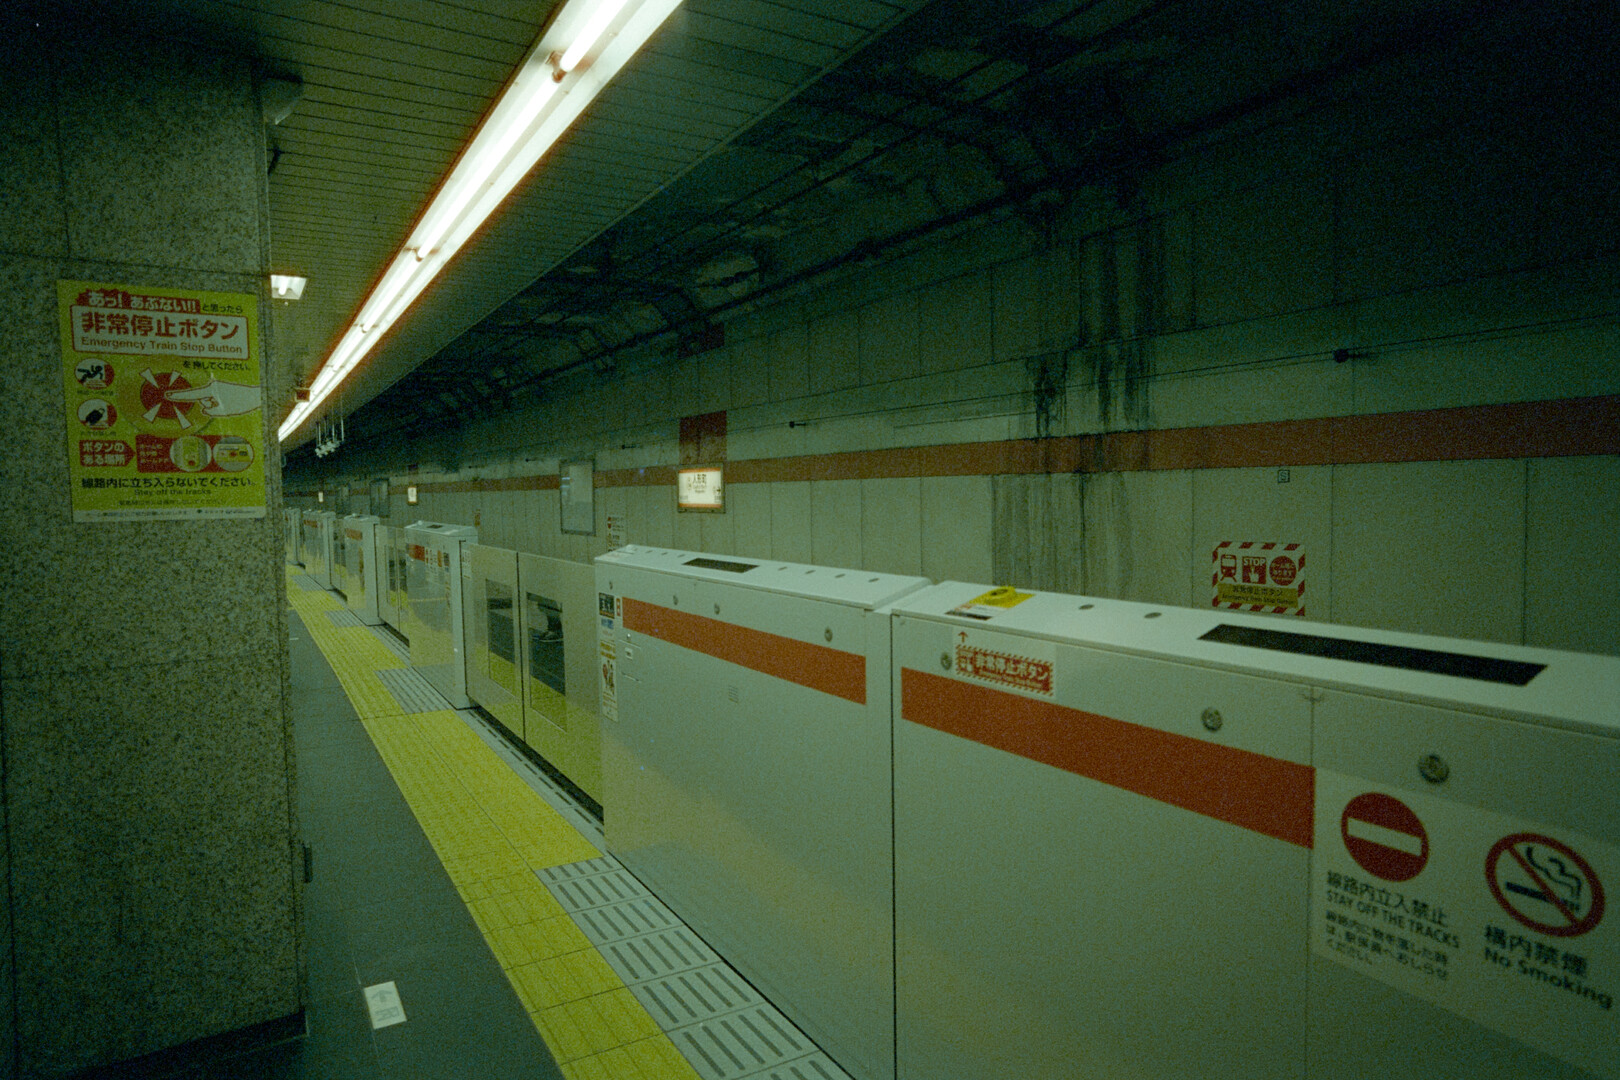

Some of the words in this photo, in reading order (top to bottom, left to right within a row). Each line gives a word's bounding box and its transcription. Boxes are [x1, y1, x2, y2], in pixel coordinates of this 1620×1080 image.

[201, 303, 244, 315] と思ったら
[81, 311, 240, 341] 非常停止ボタン
[81, 337, 146, 351] Emergency
[150, 340, 178, 351] Train
[180, 342, 206, 353] Stop
[208, 343, 243, 355] Button
[82, 441, 126, 453] ボタンの
[82, 453, 126, 467] ある場所
[1243, 557, 1267, 567] STOP
[975, 652, 1049, 681] 非常停止ボタン
[1327, 870, 1449, 928] 線路内立入禁止
[1327, 889, 1353, 906] STAY
[1356, 901, 1379, 918] OFF
[1382, 909, 1405, 929] THE
[1409, 919, 1460, 949] TRACKS
[1484, 924, 1588, 979] 構内禁煙
[1484, 947, 1511, 968] No
[1518, 960, 1613, 1011] Smoking
